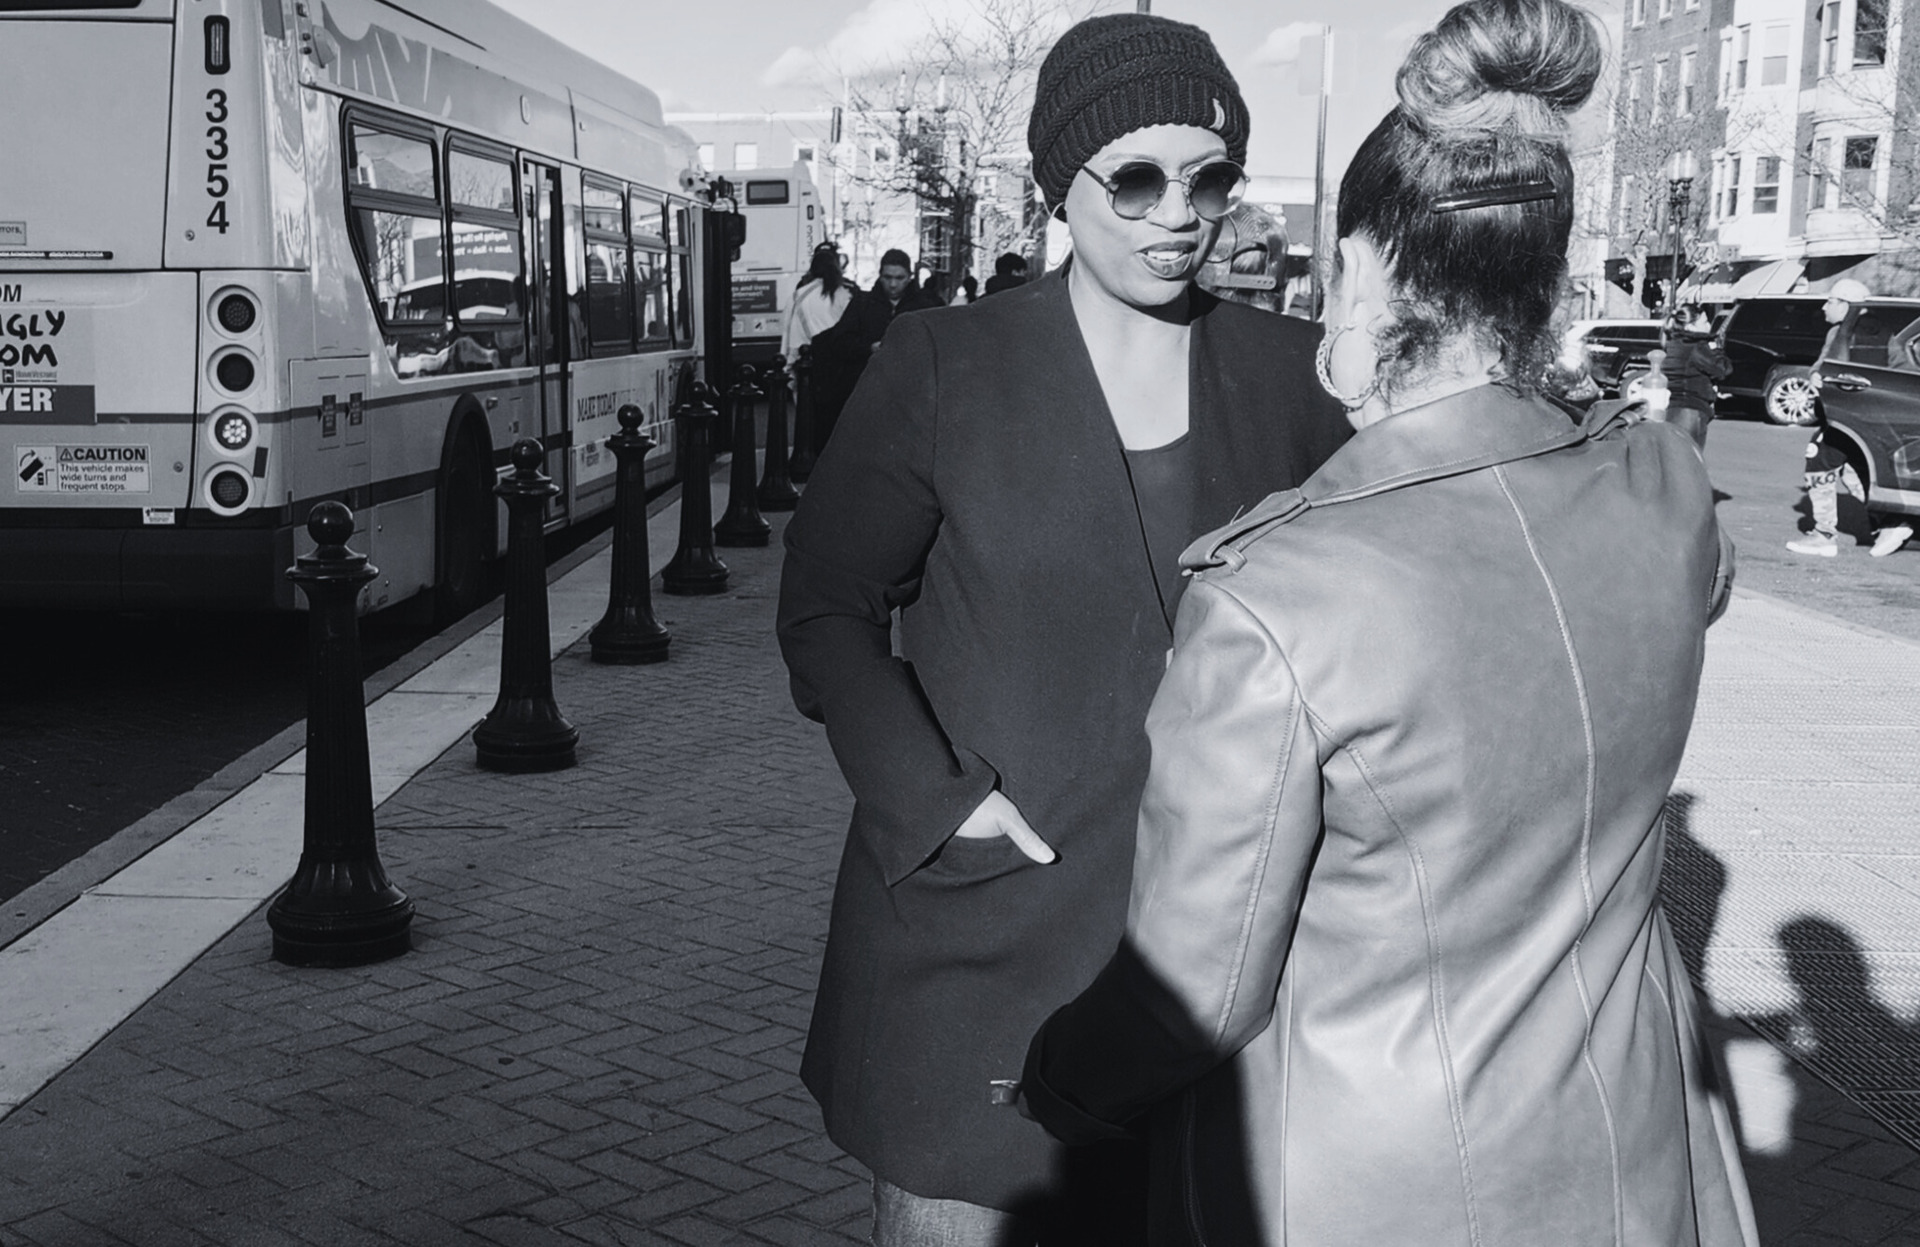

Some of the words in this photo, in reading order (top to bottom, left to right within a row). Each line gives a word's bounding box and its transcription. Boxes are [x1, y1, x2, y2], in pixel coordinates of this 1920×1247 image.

[205, 88, 230, 234] 3354
[0, 284, 22, 302] M
[0, 309, 65, 340] GLY
[577, 396, 596, 422] MAKE
[596, 391, 617, 417] TODAY
[74, 448, 146, 461] CAUTION
[61, 464, 79, 473] This
[82, 464, 112, 473] vehicle
[115, 464, 144, 473] makes
[60, 474, 81, 482] wide
[84, 474, 107, 482] turns
[109, 473, 127, 481] and
[60, 482, 98, 493] frequent
